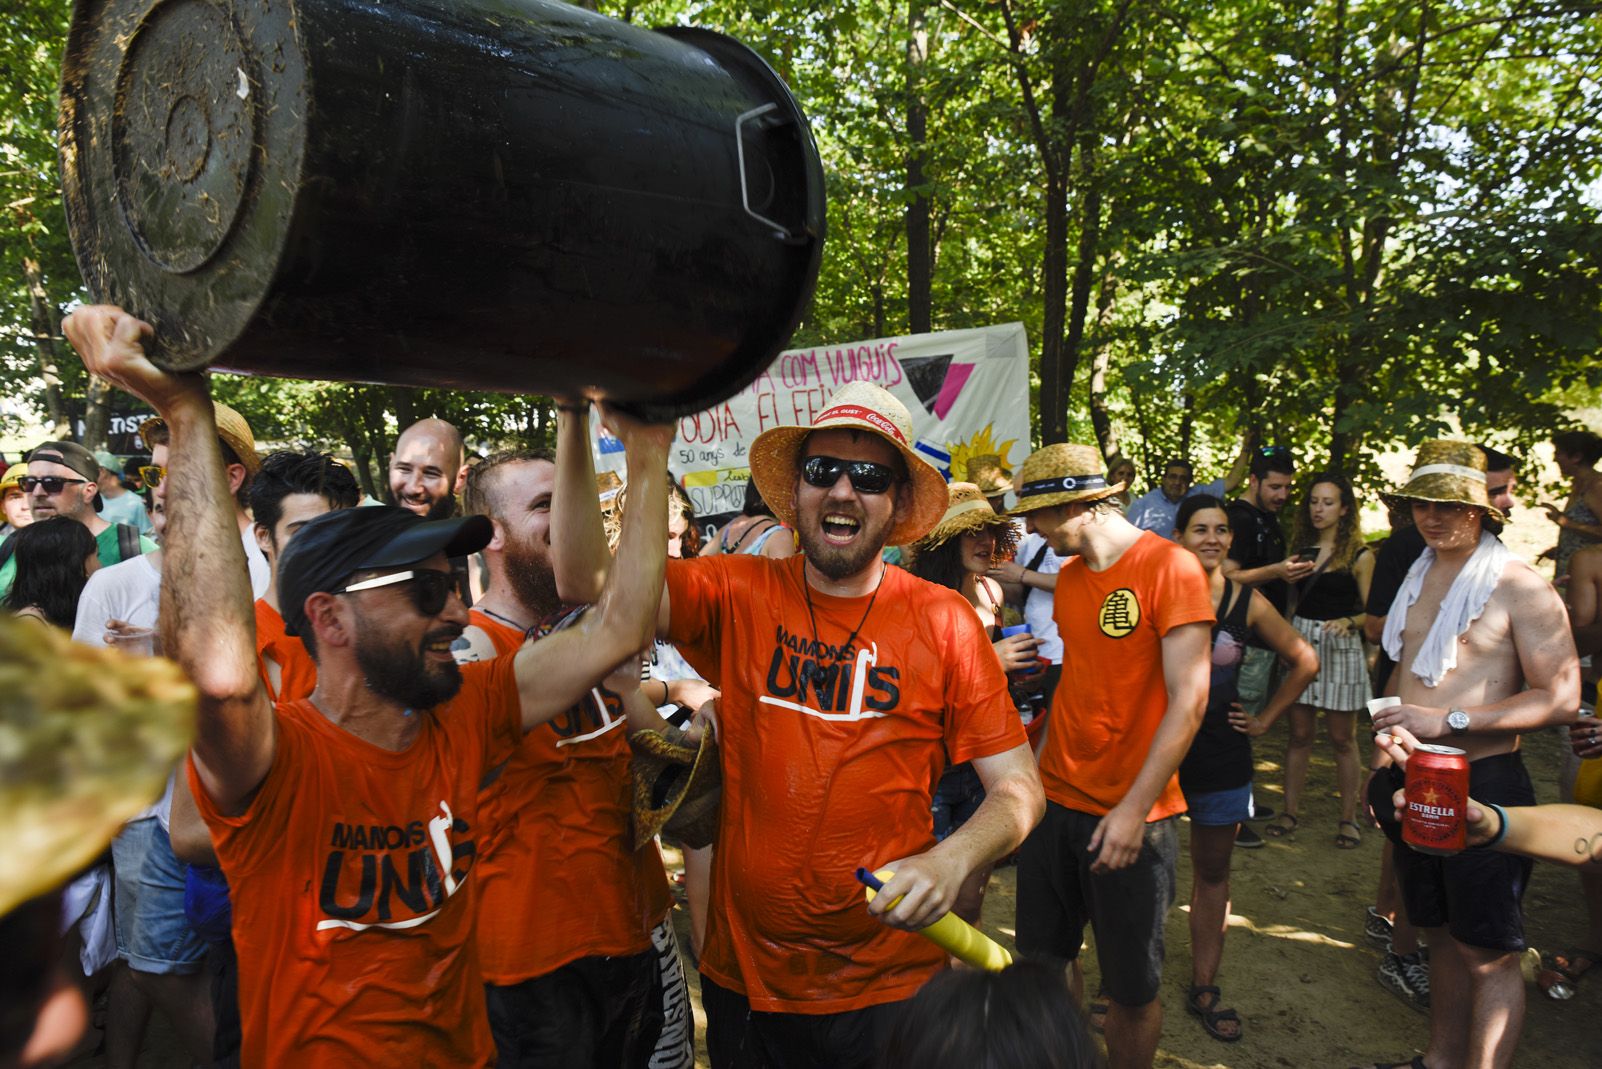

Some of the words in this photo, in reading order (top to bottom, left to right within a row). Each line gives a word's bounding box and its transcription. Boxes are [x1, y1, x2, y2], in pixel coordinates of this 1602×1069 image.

[780, 349, 822, 389] COM
[679, 448, 695, 464] 50
[699, 448, 725, 467] anys
[732, 441, 747, 457] de
[1409, 801, 1455, 817] ESTRELLA
[647, 915, 694, 1069] ONSDALE
